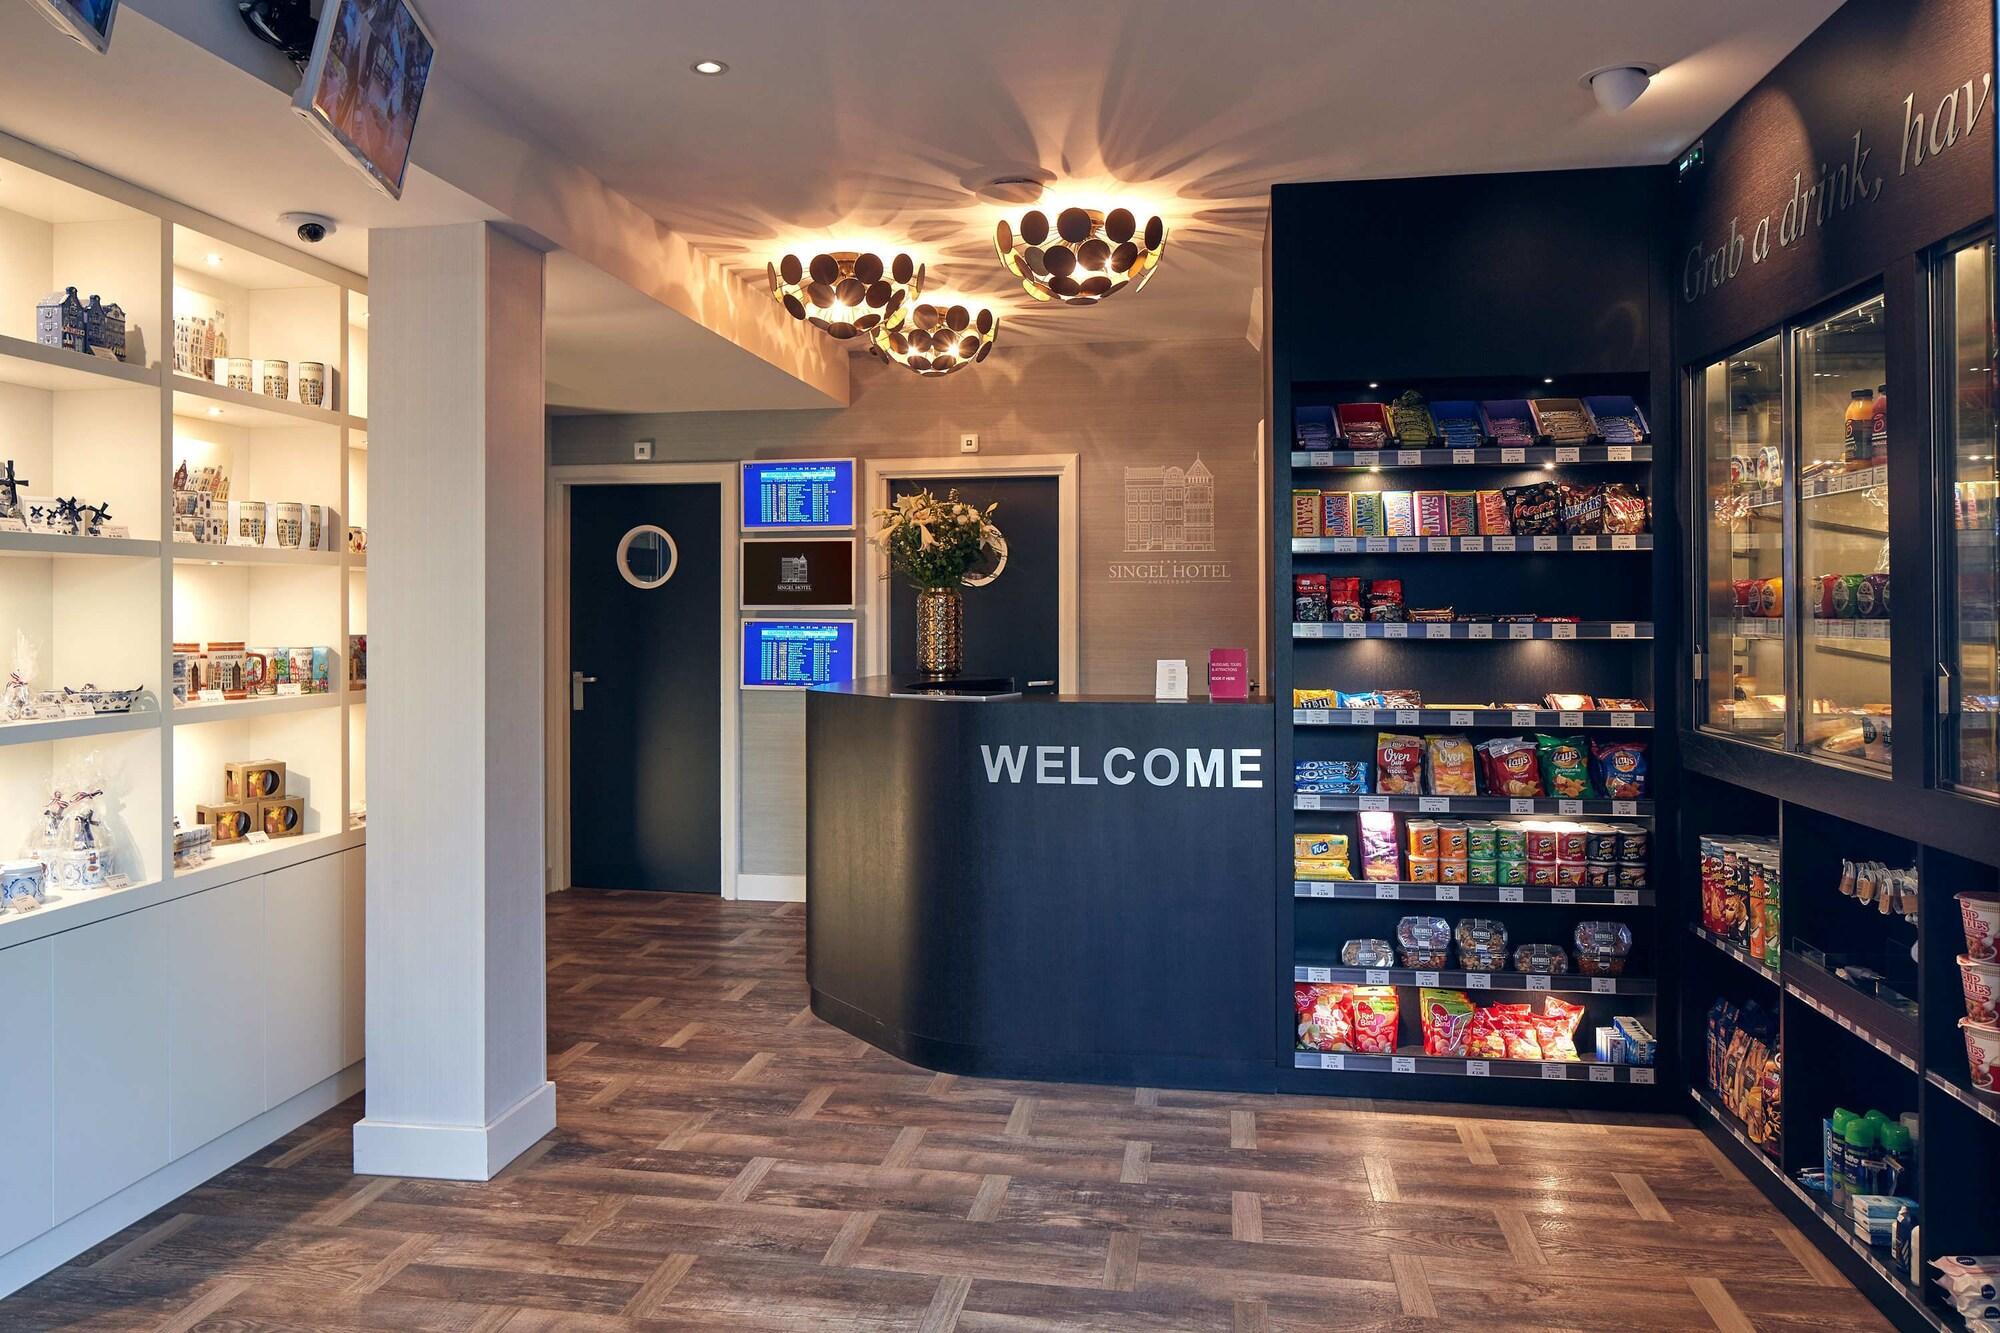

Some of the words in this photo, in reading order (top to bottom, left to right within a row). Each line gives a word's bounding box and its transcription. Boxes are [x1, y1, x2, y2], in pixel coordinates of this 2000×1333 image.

[1684, 217, 1744, 303] Grab
[1752, 215, 1770, 264] a
[1779, 128, 1884, 248] drink,
[1900, 73, 1991, 177] hav
[1108, 564, 1168, 578] SINGEL
[1172, 564, 1232, 578] HOTEL
[1384, 748, 1411, 763] Oven
[980, 744, 1263, 789] WELCOME
[1312, 844, 1328, 855] TUC
[1361, 1012, 1374, 1020] Red
[1435, 1013, 1448, 1021] Red
[1435, 1020, 1451, 1028] Band
